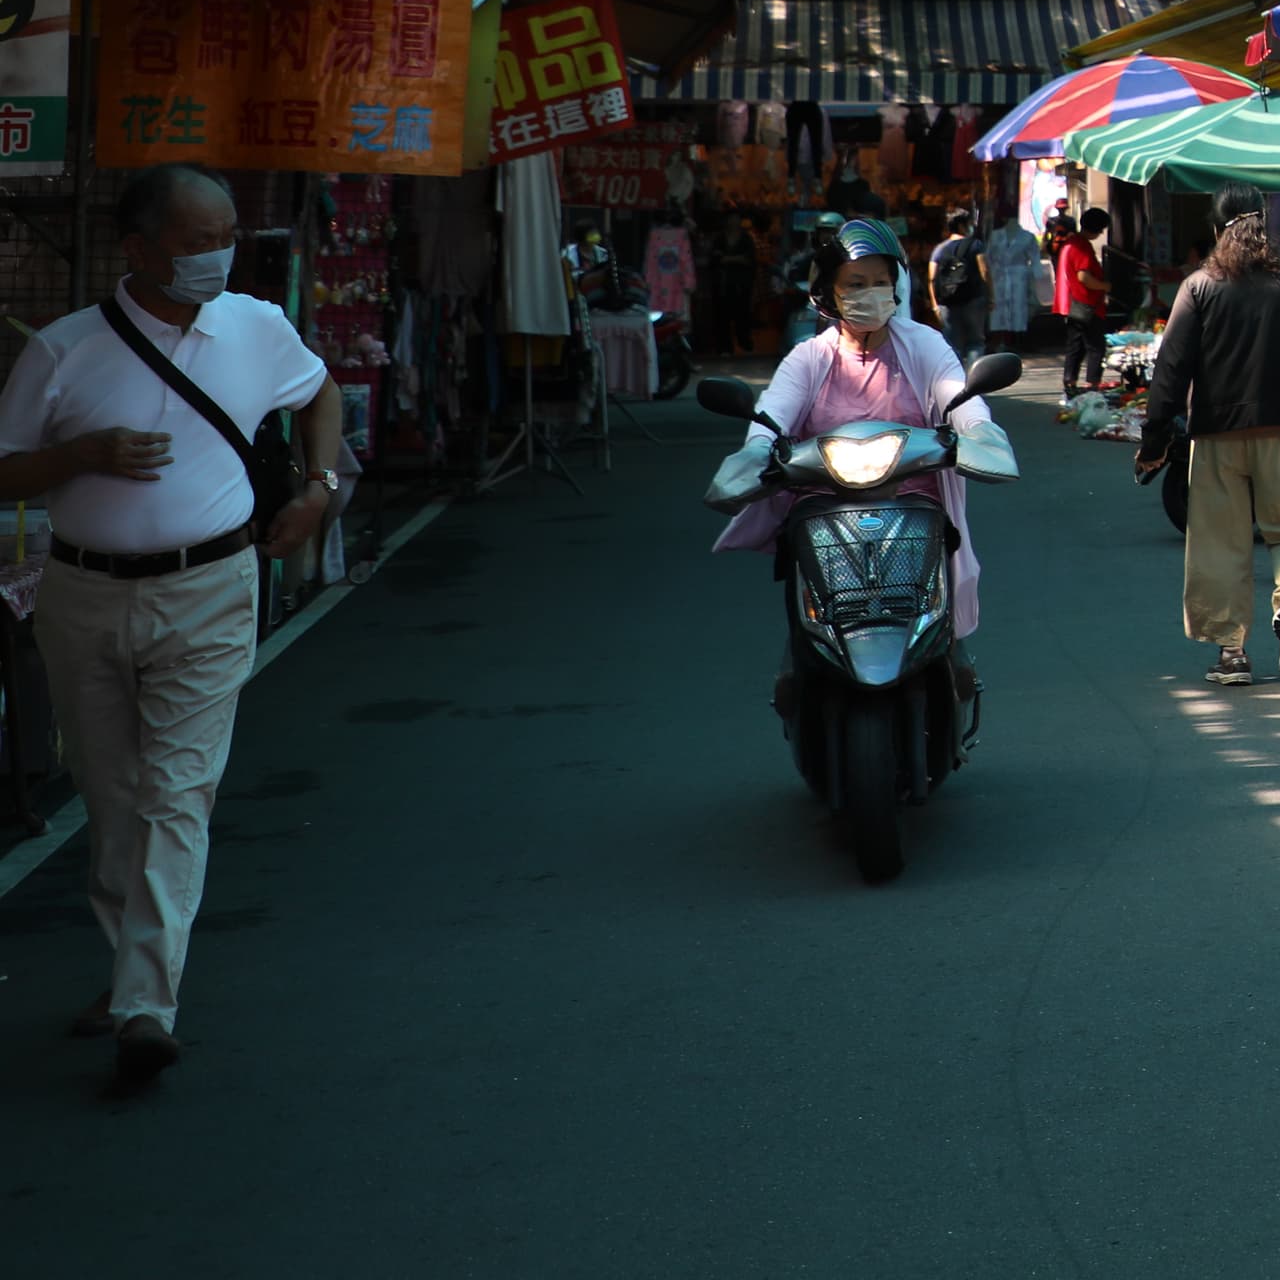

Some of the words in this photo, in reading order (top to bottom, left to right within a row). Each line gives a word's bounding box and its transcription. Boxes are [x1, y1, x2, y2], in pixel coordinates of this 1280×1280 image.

[121, 93, 207, 145] 花生
[347, 101, 434, 153] 芝麻
[488, 86, 630, 155] 在這裡
